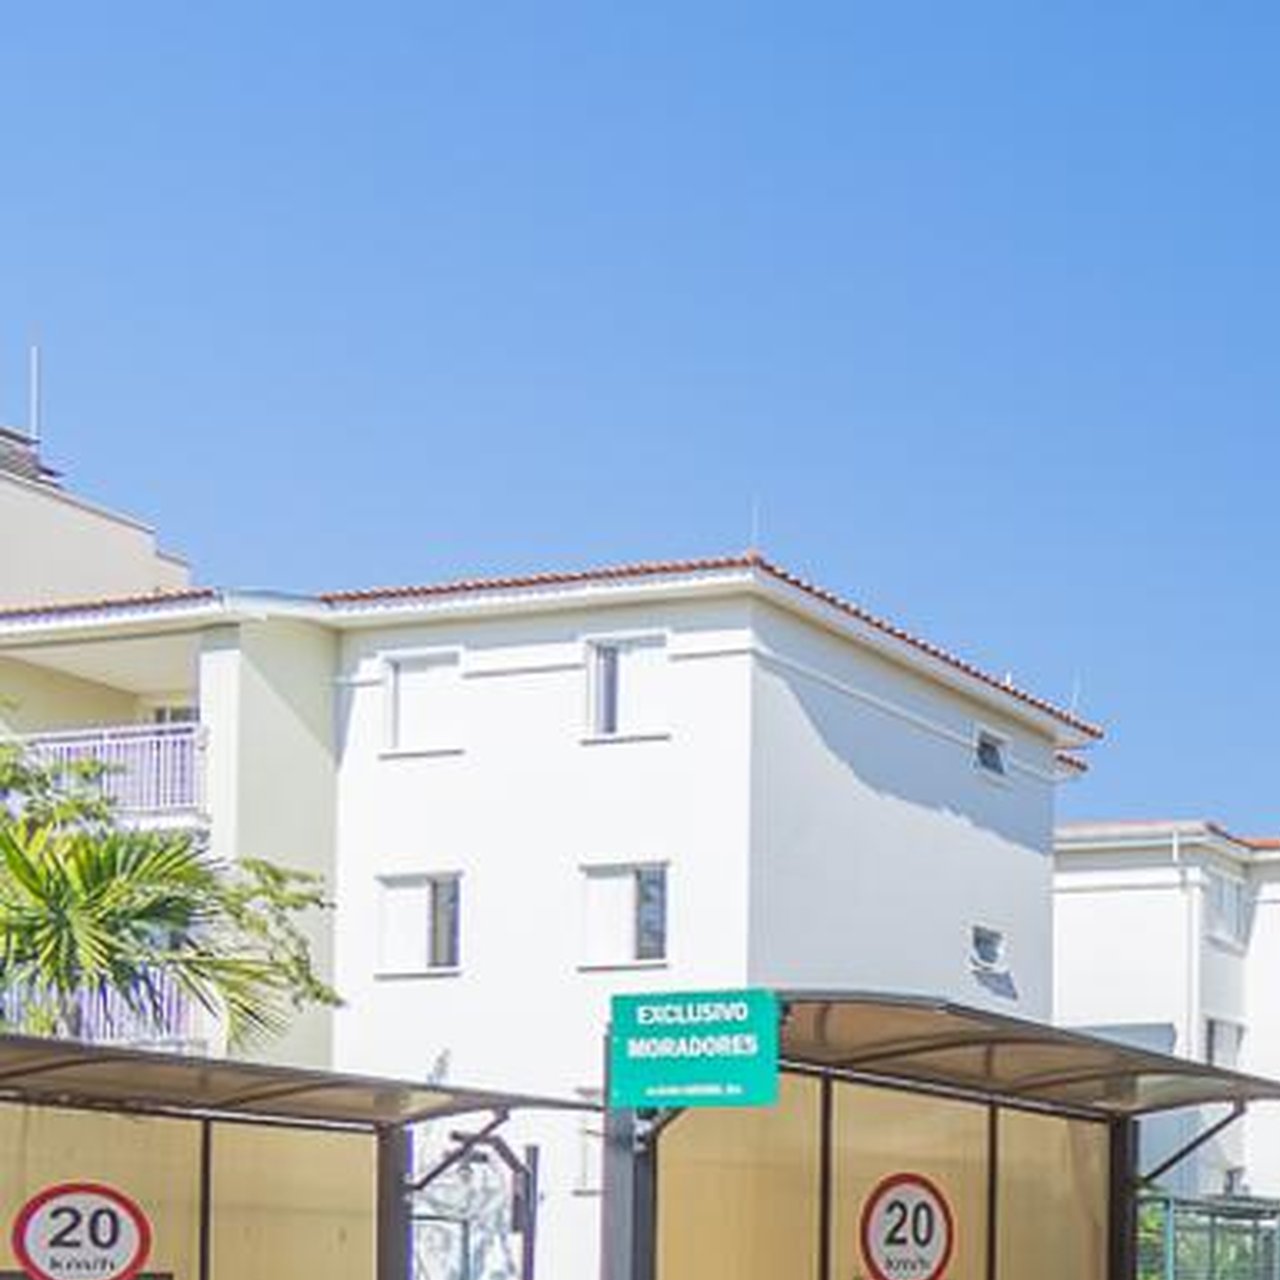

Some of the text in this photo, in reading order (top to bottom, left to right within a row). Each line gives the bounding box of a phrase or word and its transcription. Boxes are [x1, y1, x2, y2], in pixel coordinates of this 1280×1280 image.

[637, 1003, 749, 1025] EXCLUSIVO
[628, 1035, 758, 1058] MORADORES
[48, 1205, 120, 1250] 20
[883, 1198, 934, 1248] 20
